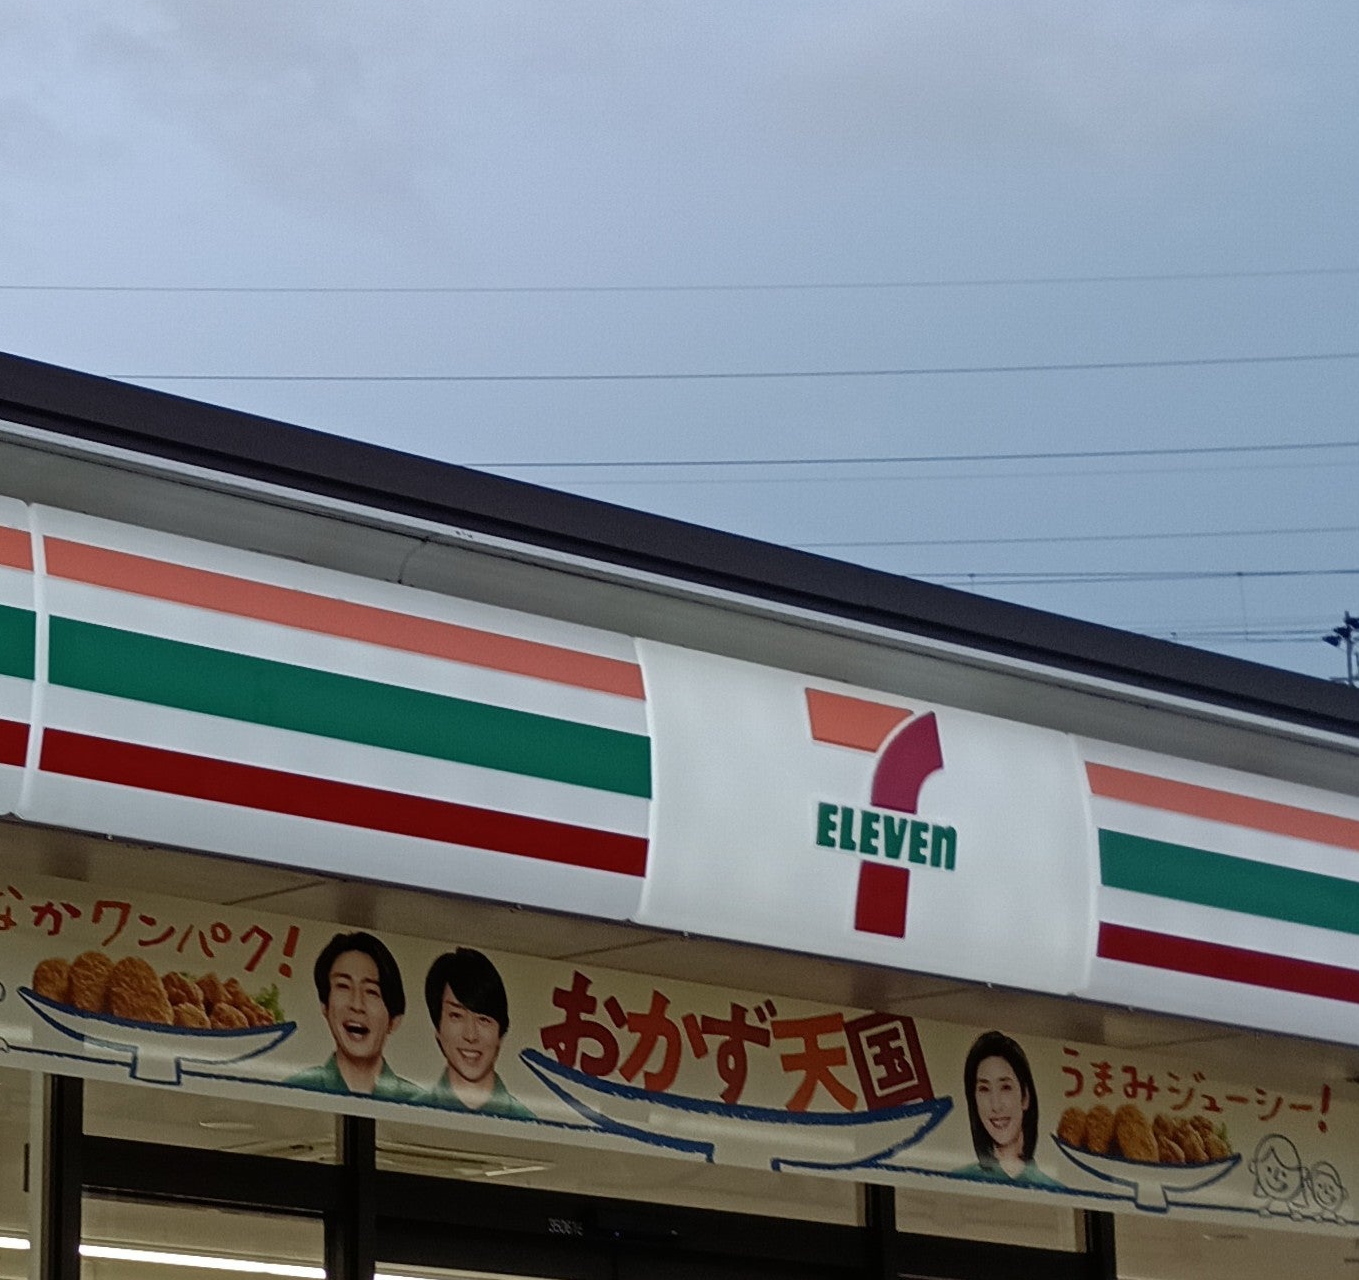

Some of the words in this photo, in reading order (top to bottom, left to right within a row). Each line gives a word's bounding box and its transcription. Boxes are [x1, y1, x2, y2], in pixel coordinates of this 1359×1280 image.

[540, 970, 935, 1113] おかず天国
